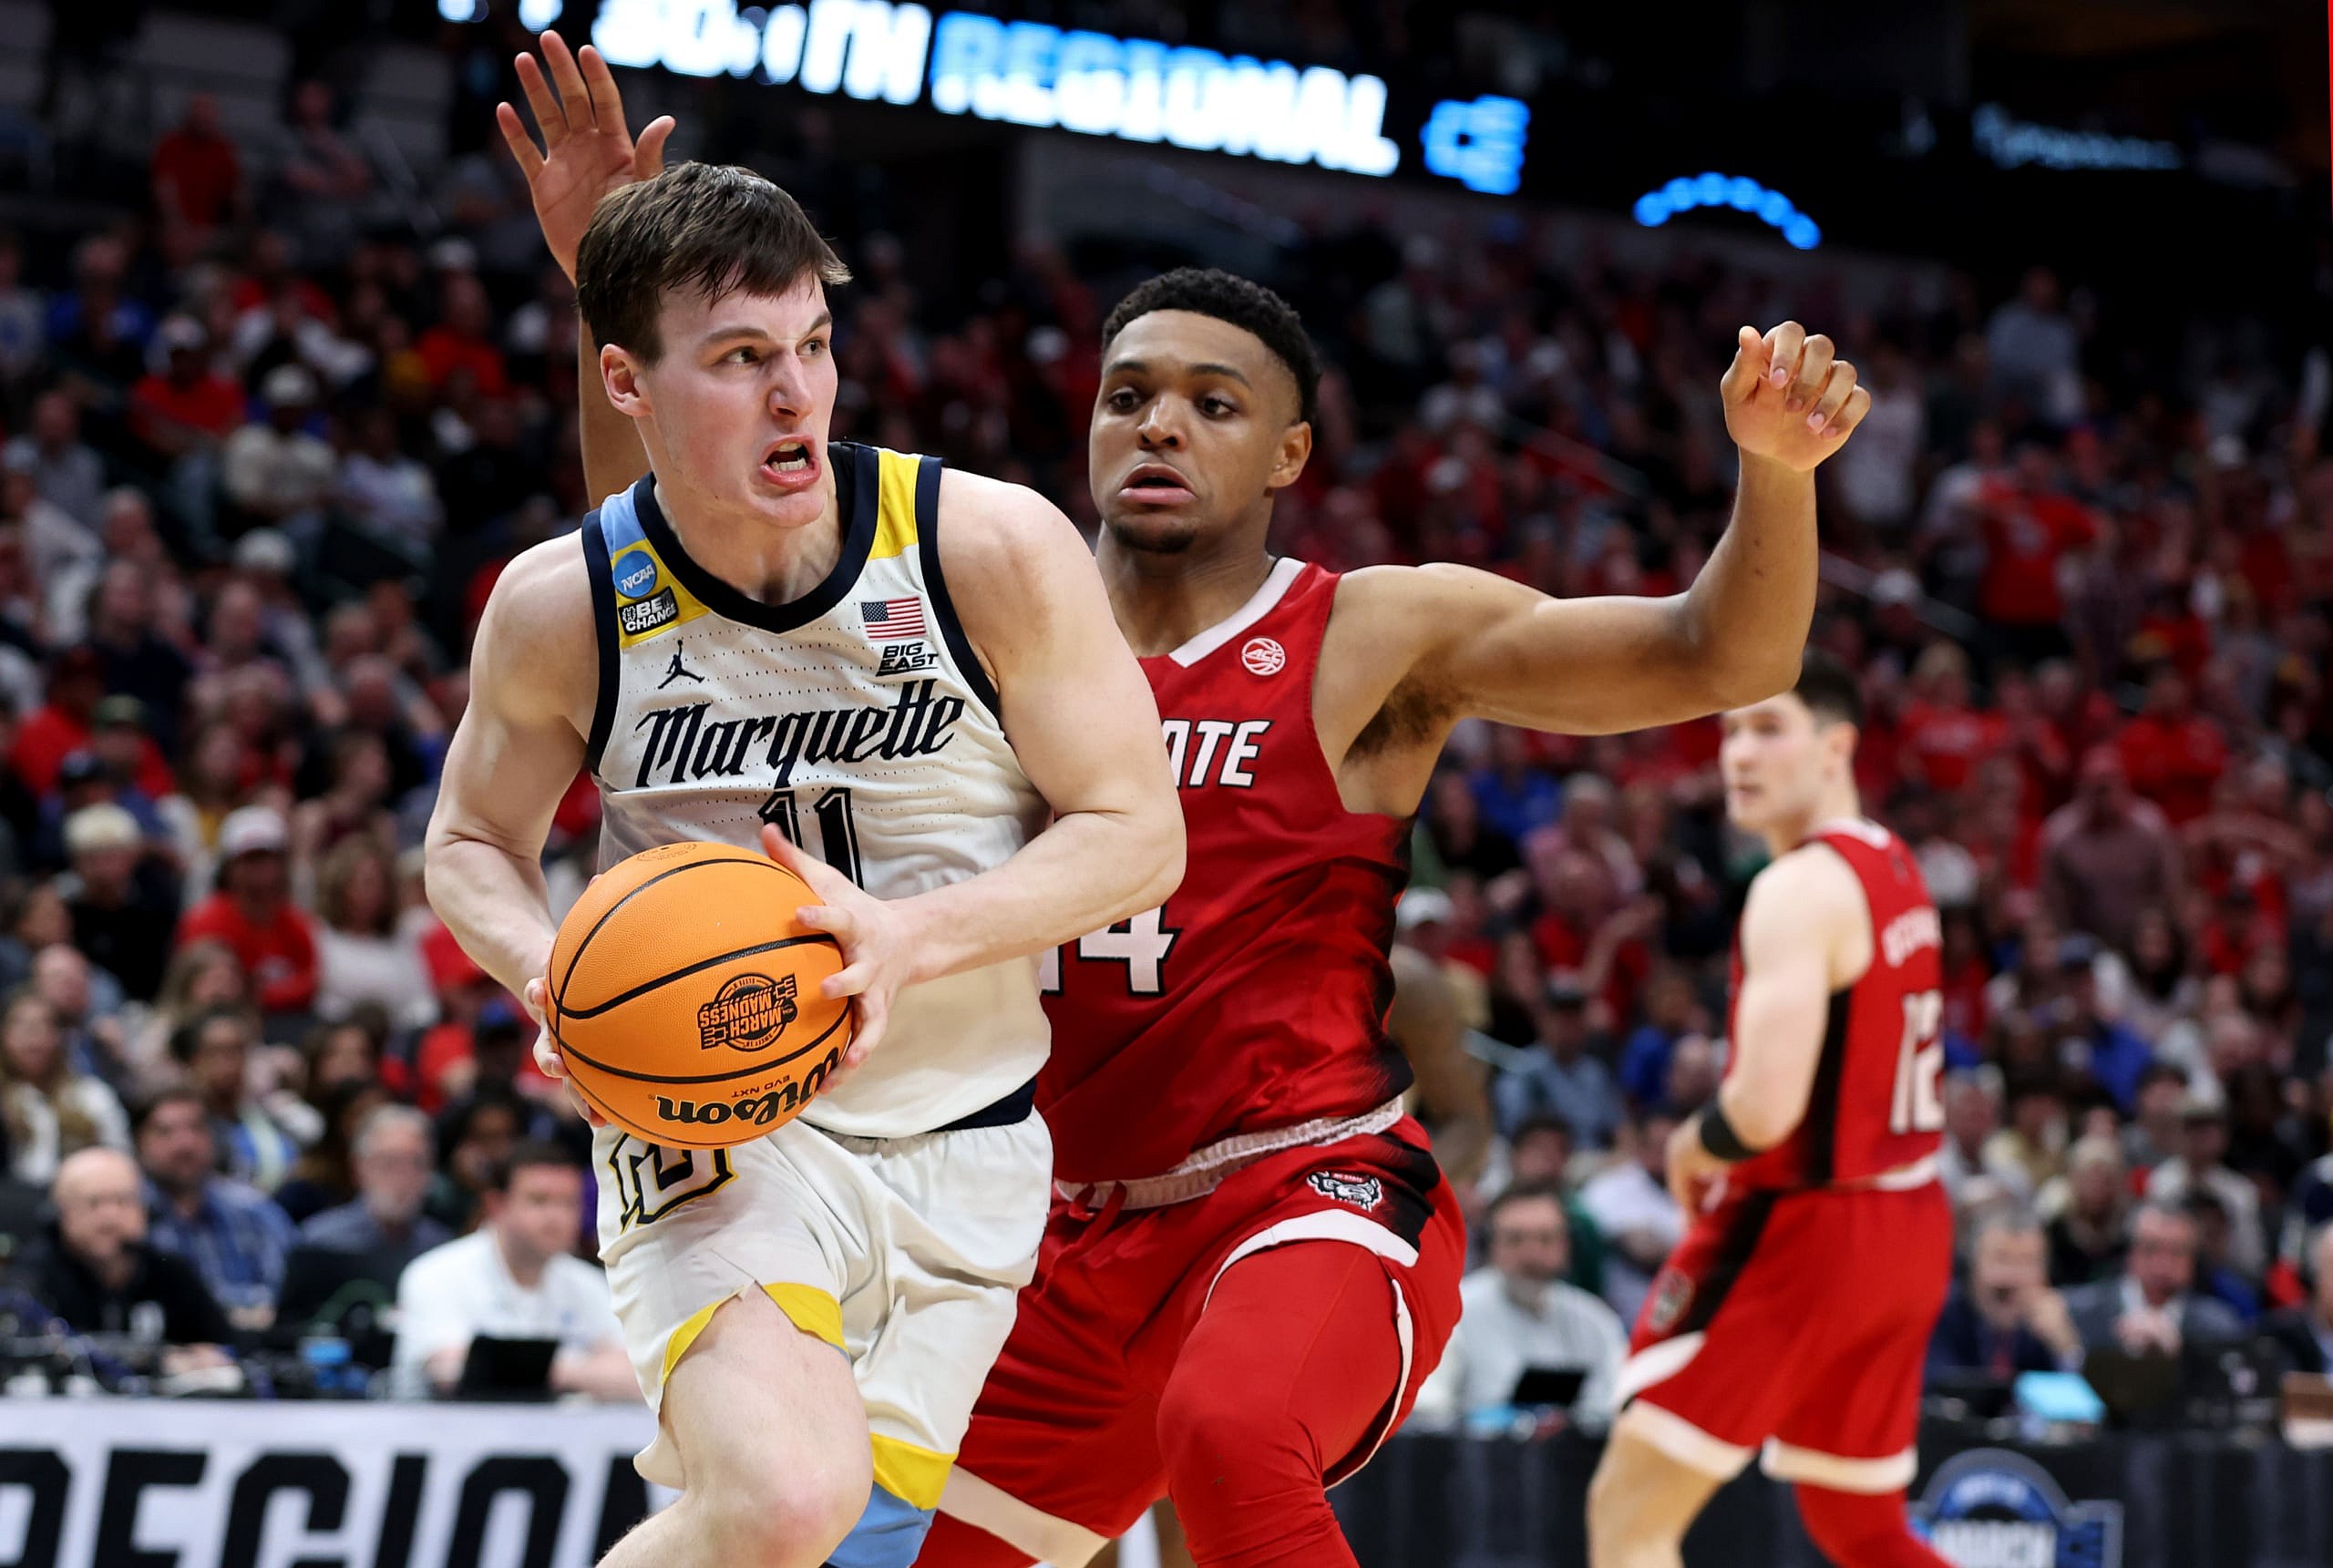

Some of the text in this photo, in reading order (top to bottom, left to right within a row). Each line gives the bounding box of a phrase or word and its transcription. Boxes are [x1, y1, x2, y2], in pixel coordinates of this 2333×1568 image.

[930, 11, 1401, 178] REGIONAL
[621, 564, 655, 591] NCAA
[625, 603, 677, 631] CHANGE
[879, 651, 939, 672] EAST
[882, 641, 925, 658] BIG
[635, 678, 965, 788] Marquette
[1161, 718, 1274, 789] ATE
[698, 988, 773, 1028] MADNESS
[729, 1005, 783, 1039] MARCH
[1890, 988, 1946, 1133] 12
[655, 1047, 839, 1126] Wilson
[731, 1074, 790, 1099] EVO NXT
